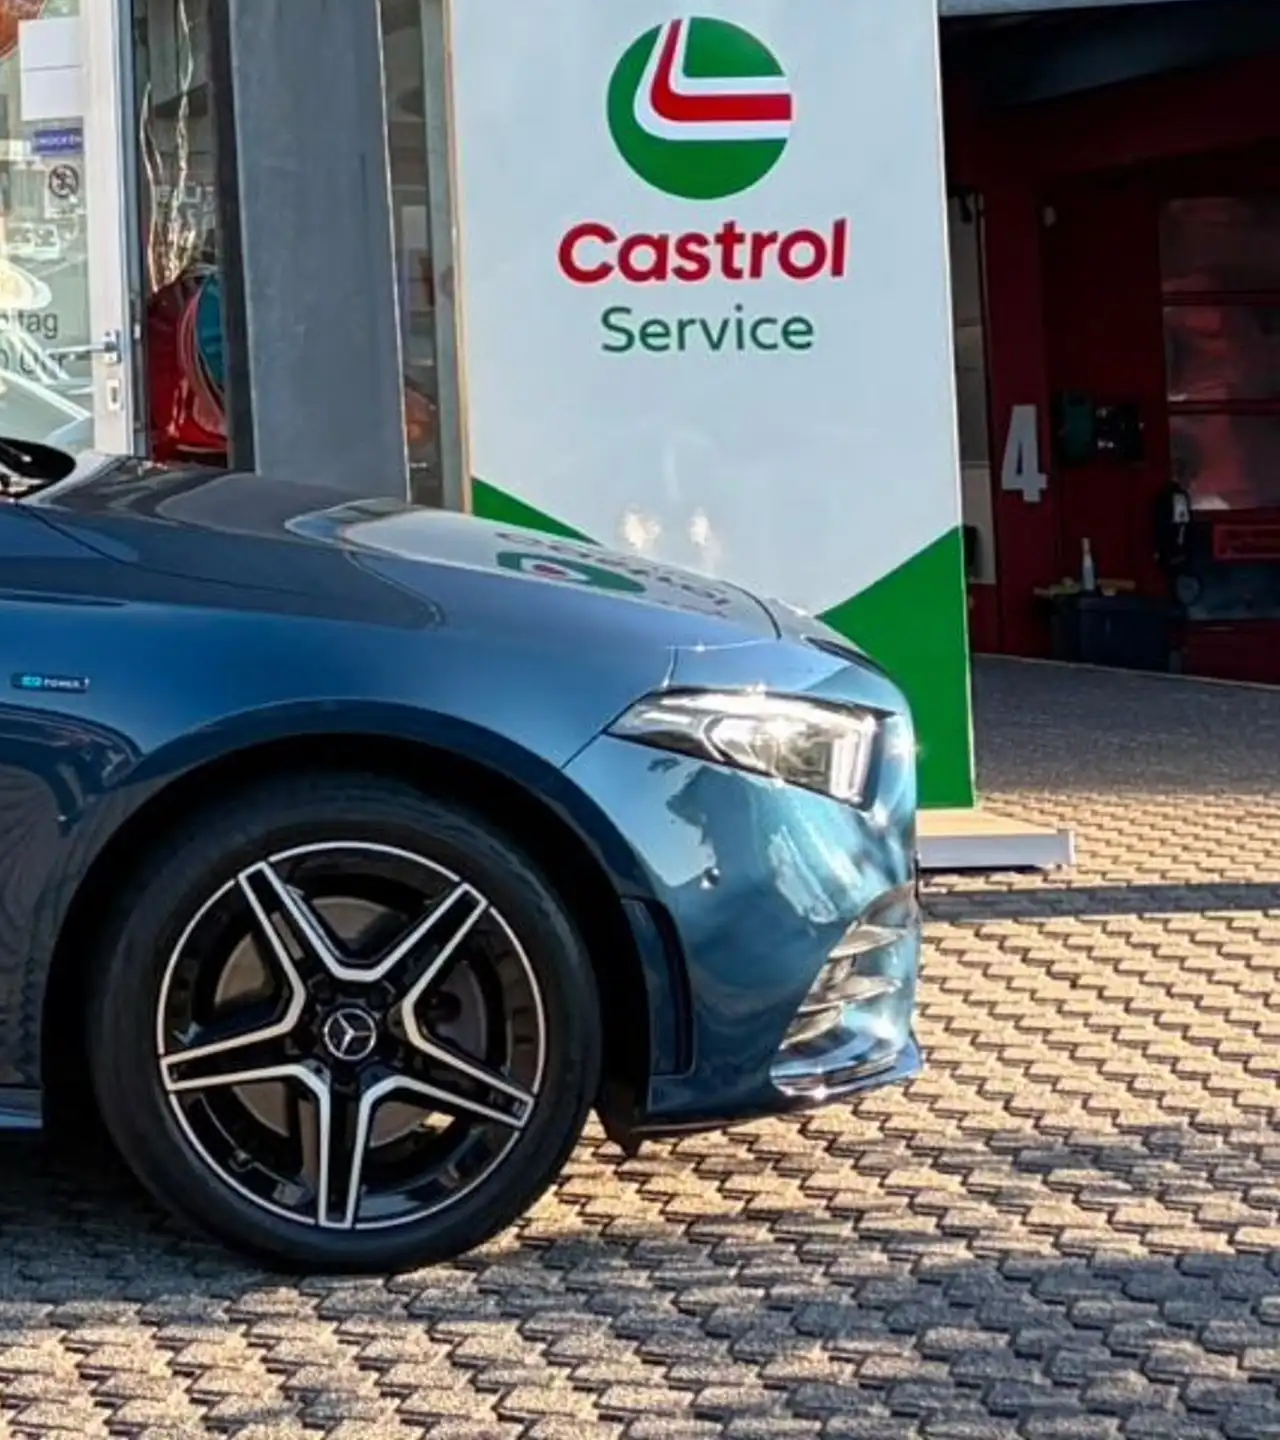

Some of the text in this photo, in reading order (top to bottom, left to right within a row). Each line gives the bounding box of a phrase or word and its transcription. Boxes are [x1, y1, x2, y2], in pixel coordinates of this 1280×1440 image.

[557, 218, 847, 285] Castrol
[600, 304, 815, 353] Service
[1001, 403, 1048, 503] 4
